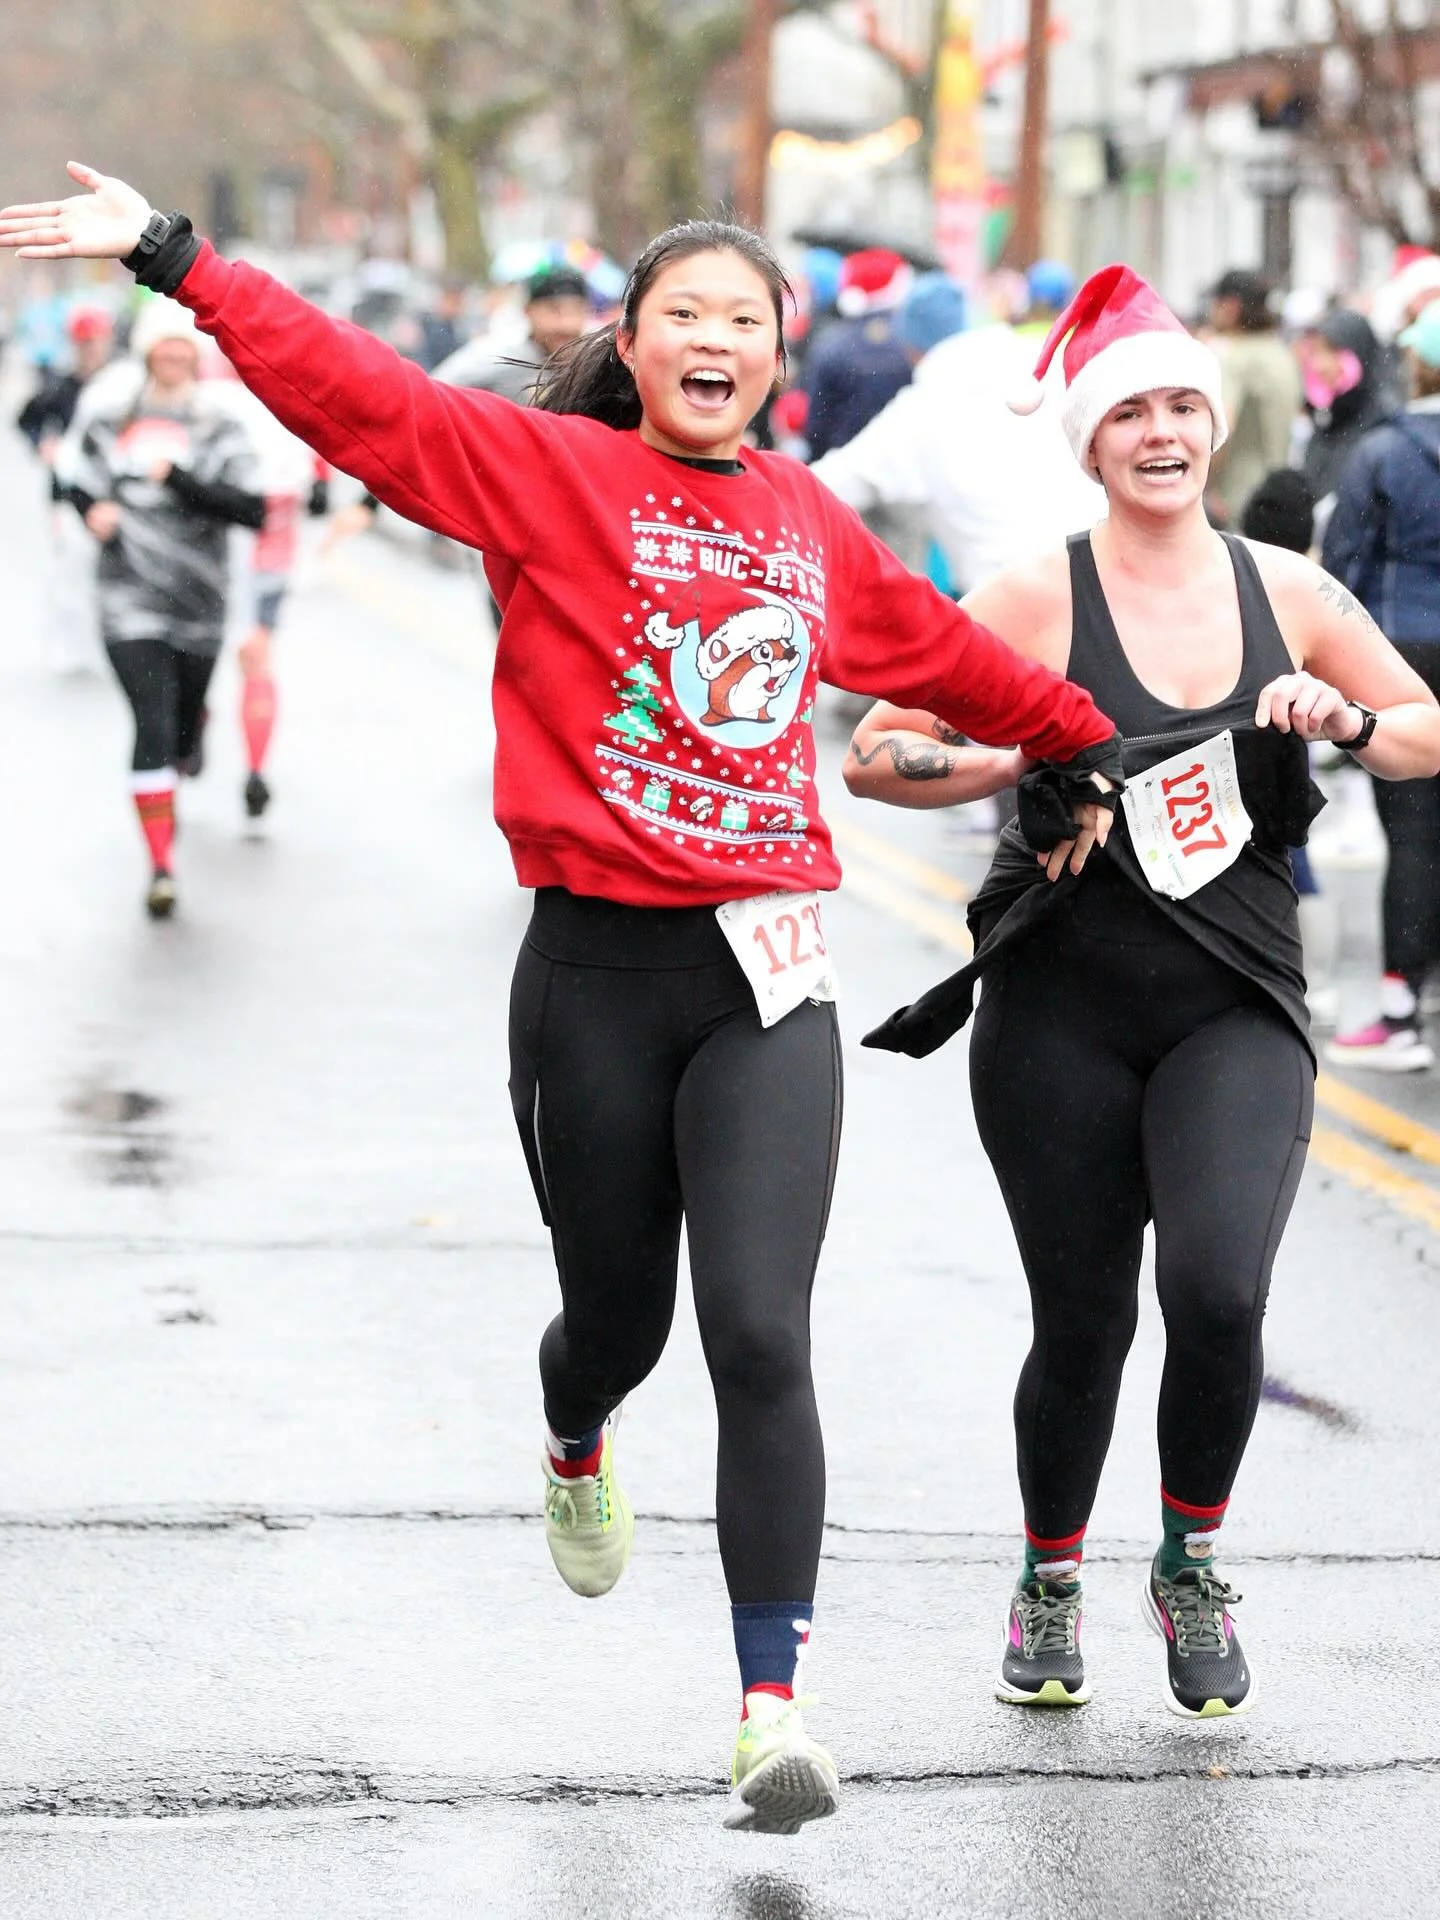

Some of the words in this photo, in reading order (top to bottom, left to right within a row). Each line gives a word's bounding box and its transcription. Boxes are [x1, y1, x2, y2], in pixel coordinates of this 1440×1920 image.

[699, 547, 808, 595] BUC-EE'S
[1161, 763, 1228, 858] 1237
[753, 902, 826, 975] 123
